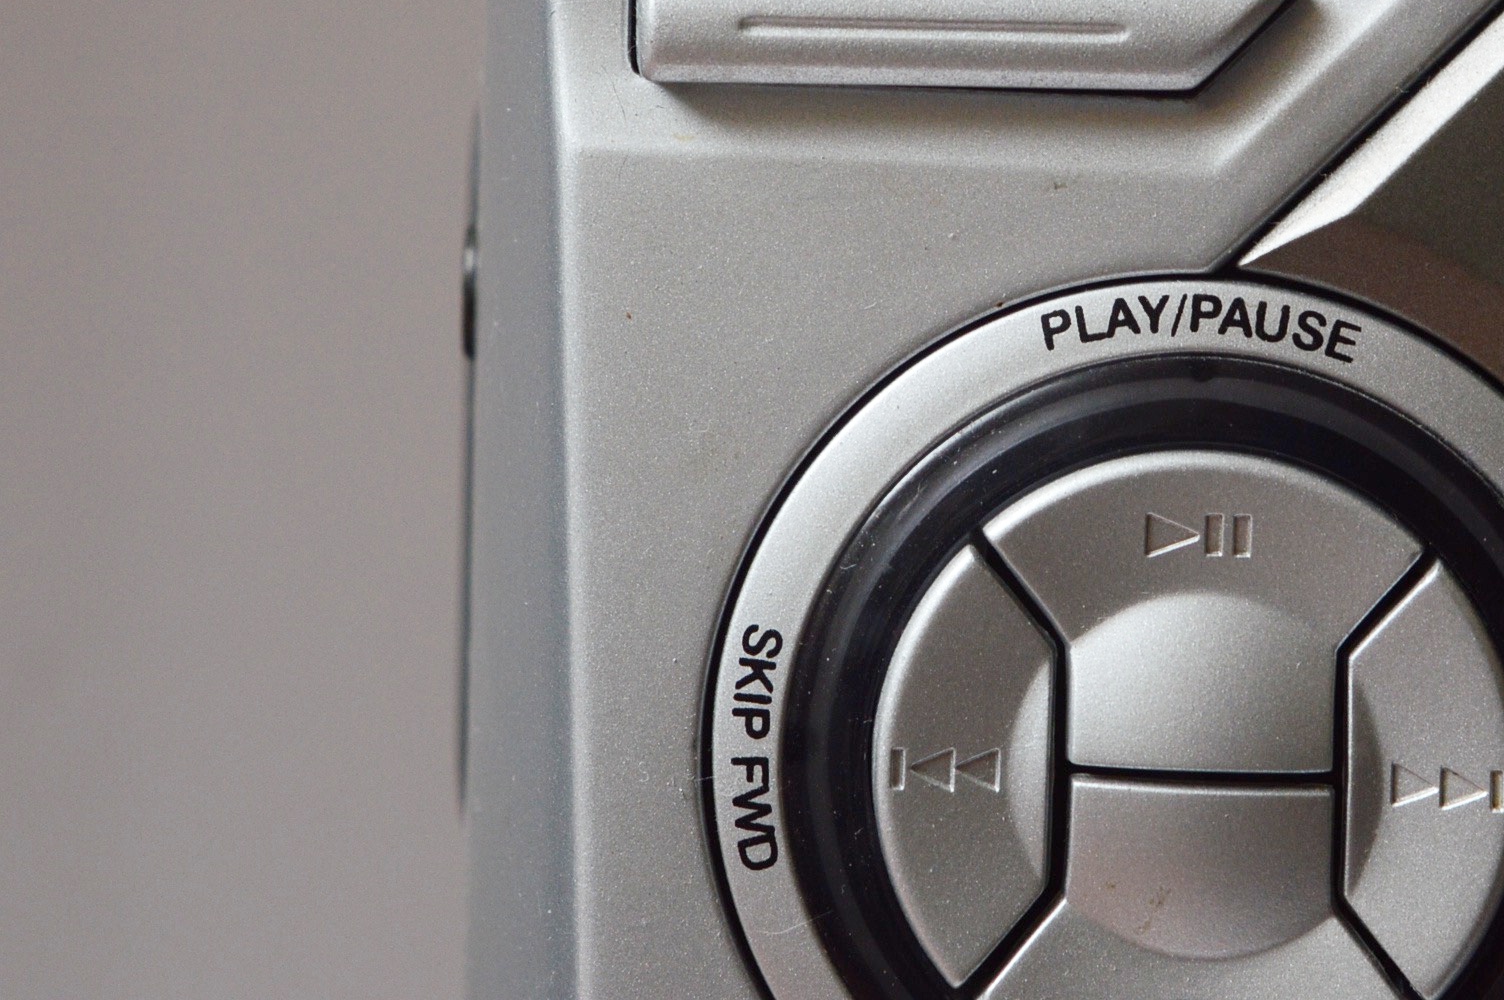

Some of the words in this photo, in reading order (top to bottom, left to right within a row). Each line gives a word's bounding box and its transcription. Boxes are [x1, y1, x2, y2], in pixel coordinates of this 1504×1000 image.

[1040, 292, 1362, 364] PLAY/PAUSE
[732, 624, 784, 741] SKIP
[729, 754, 779, 874] FWD
